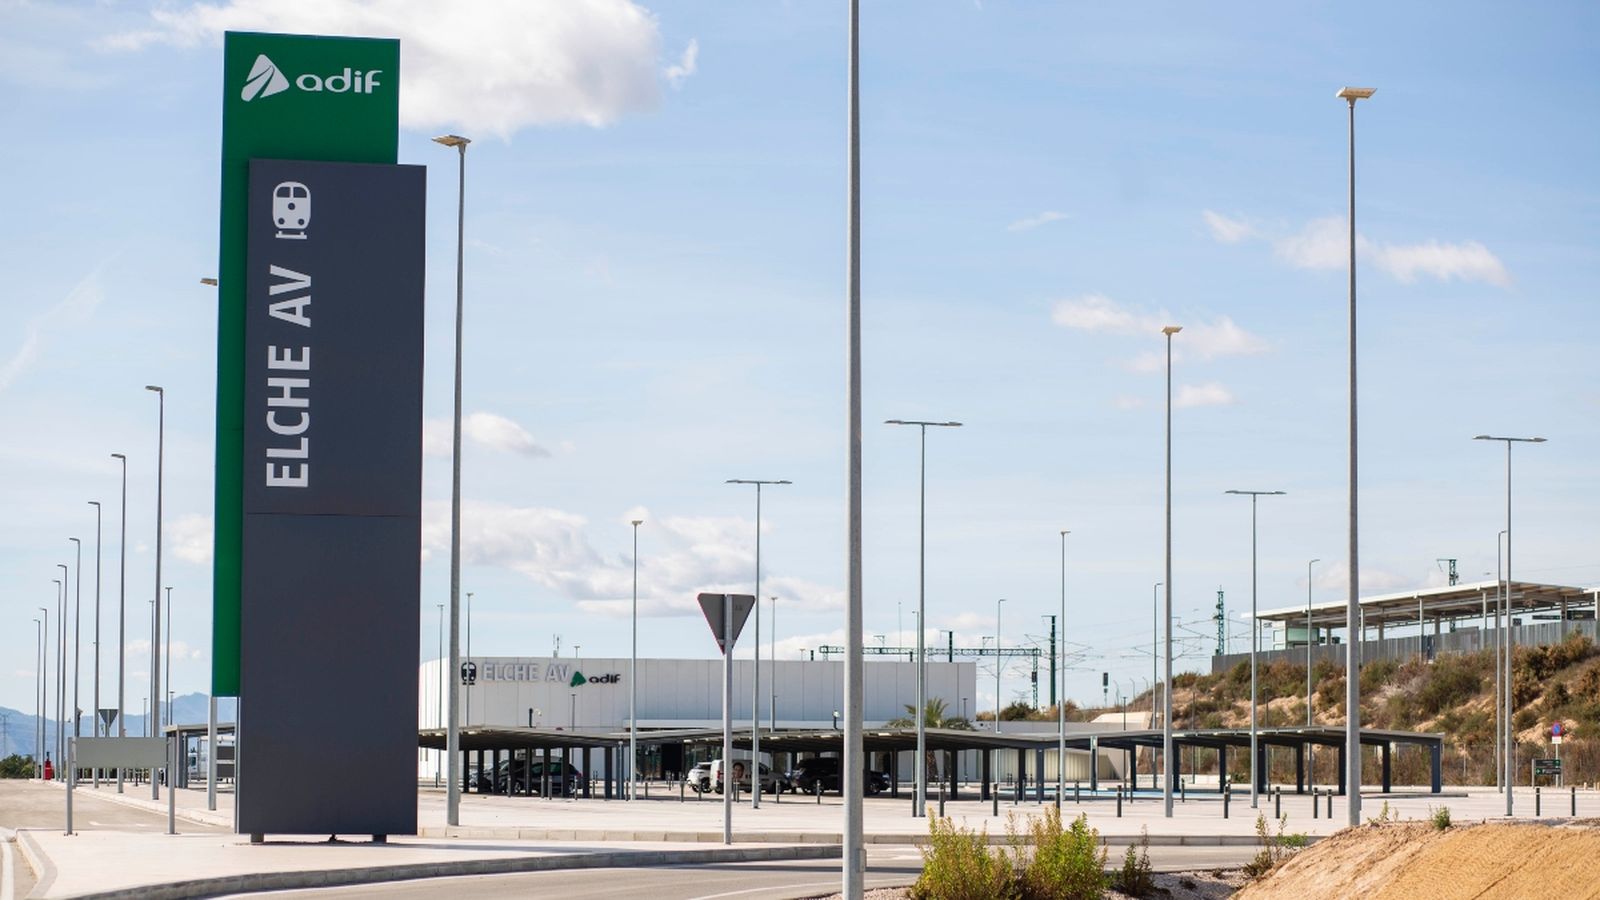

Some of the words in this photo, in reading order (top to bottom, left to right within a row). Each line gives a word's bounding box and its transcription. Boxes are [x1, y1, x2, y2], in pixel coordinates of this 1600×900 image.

[296, 68, 383, 94] adif
[268, 265, 312, 328] AV
[266, 345, 310, 488] ELCHE
[482, 663, 539, 681] ELCHE
[545, 664, 570, 682] AV
[588, 673, 621, 684] adif
